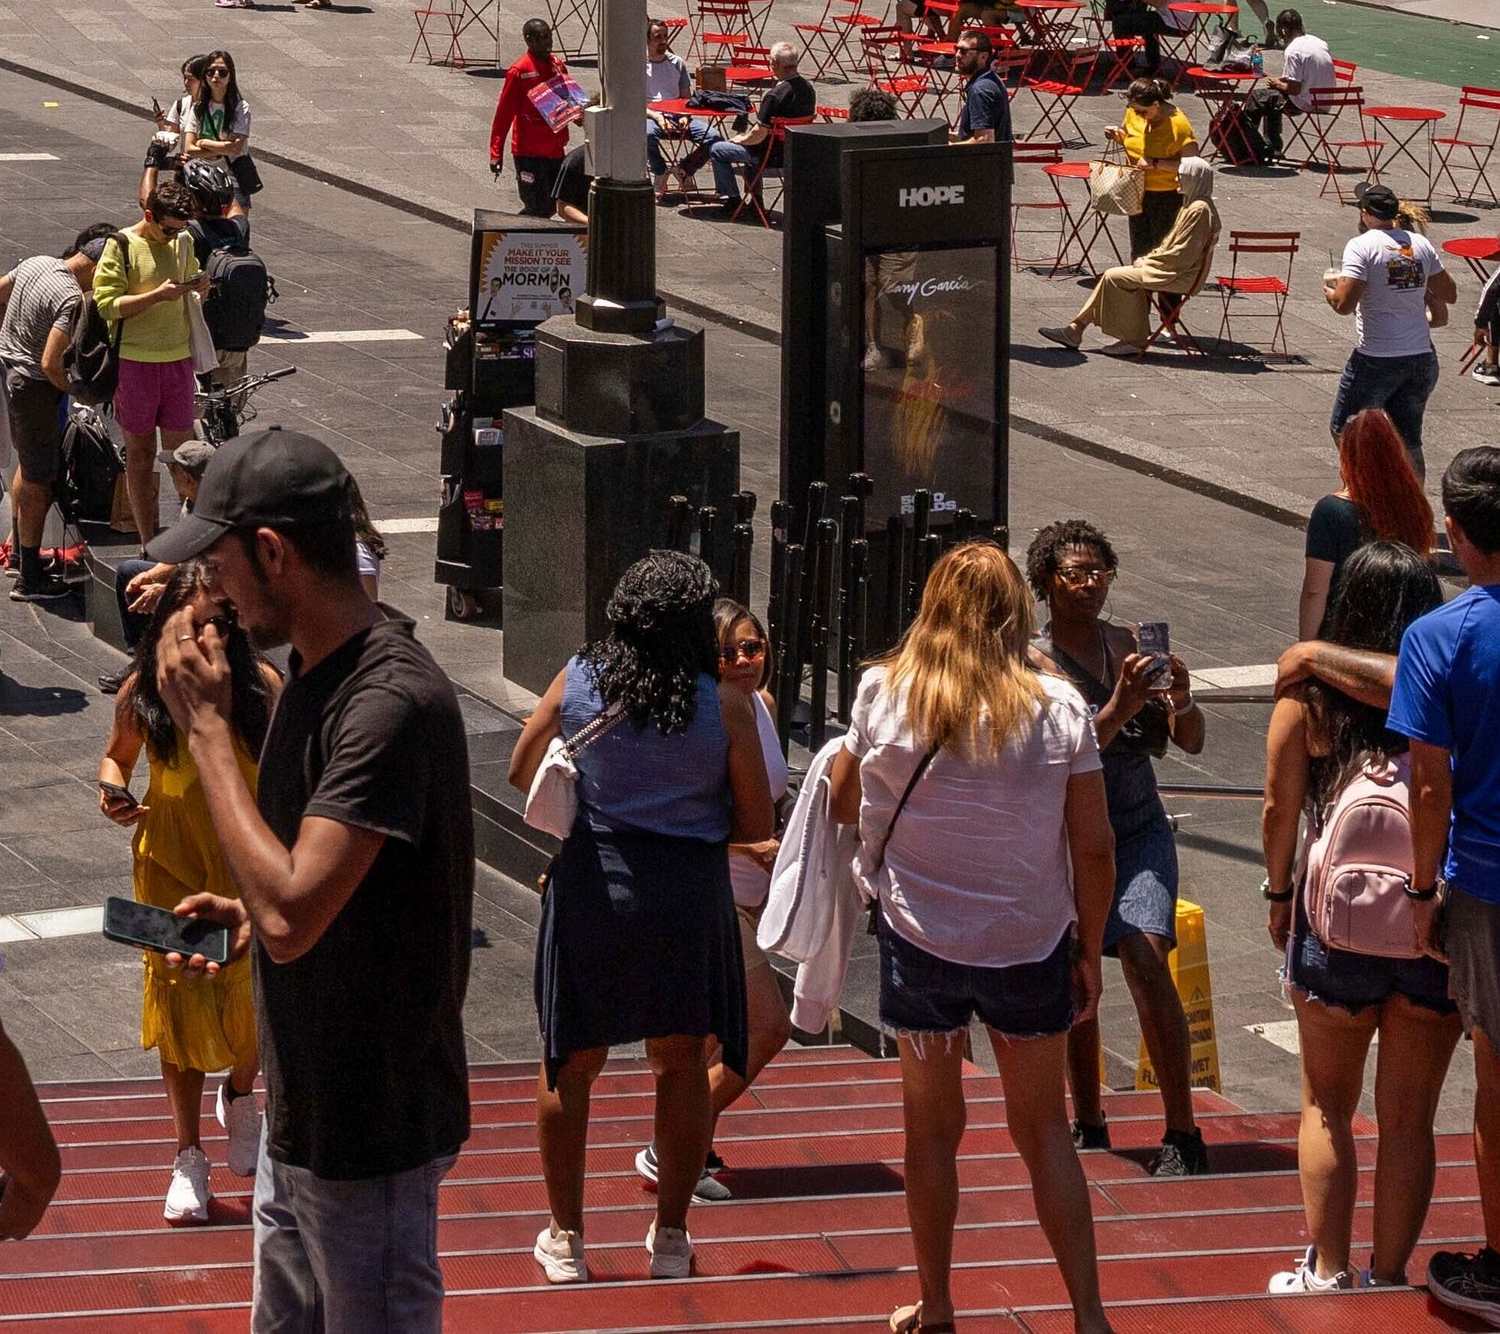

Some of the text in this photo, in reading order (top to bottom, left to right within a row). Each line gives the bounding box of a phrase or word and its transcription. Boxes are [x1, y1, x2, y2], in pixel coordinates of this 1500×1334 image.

[900, 185, 964, 208] HOPE
[508, 249, 533, 257] MAKE
[544, 249, 569, 257] YOUR
[504, 257, 540, 265] MISSION
